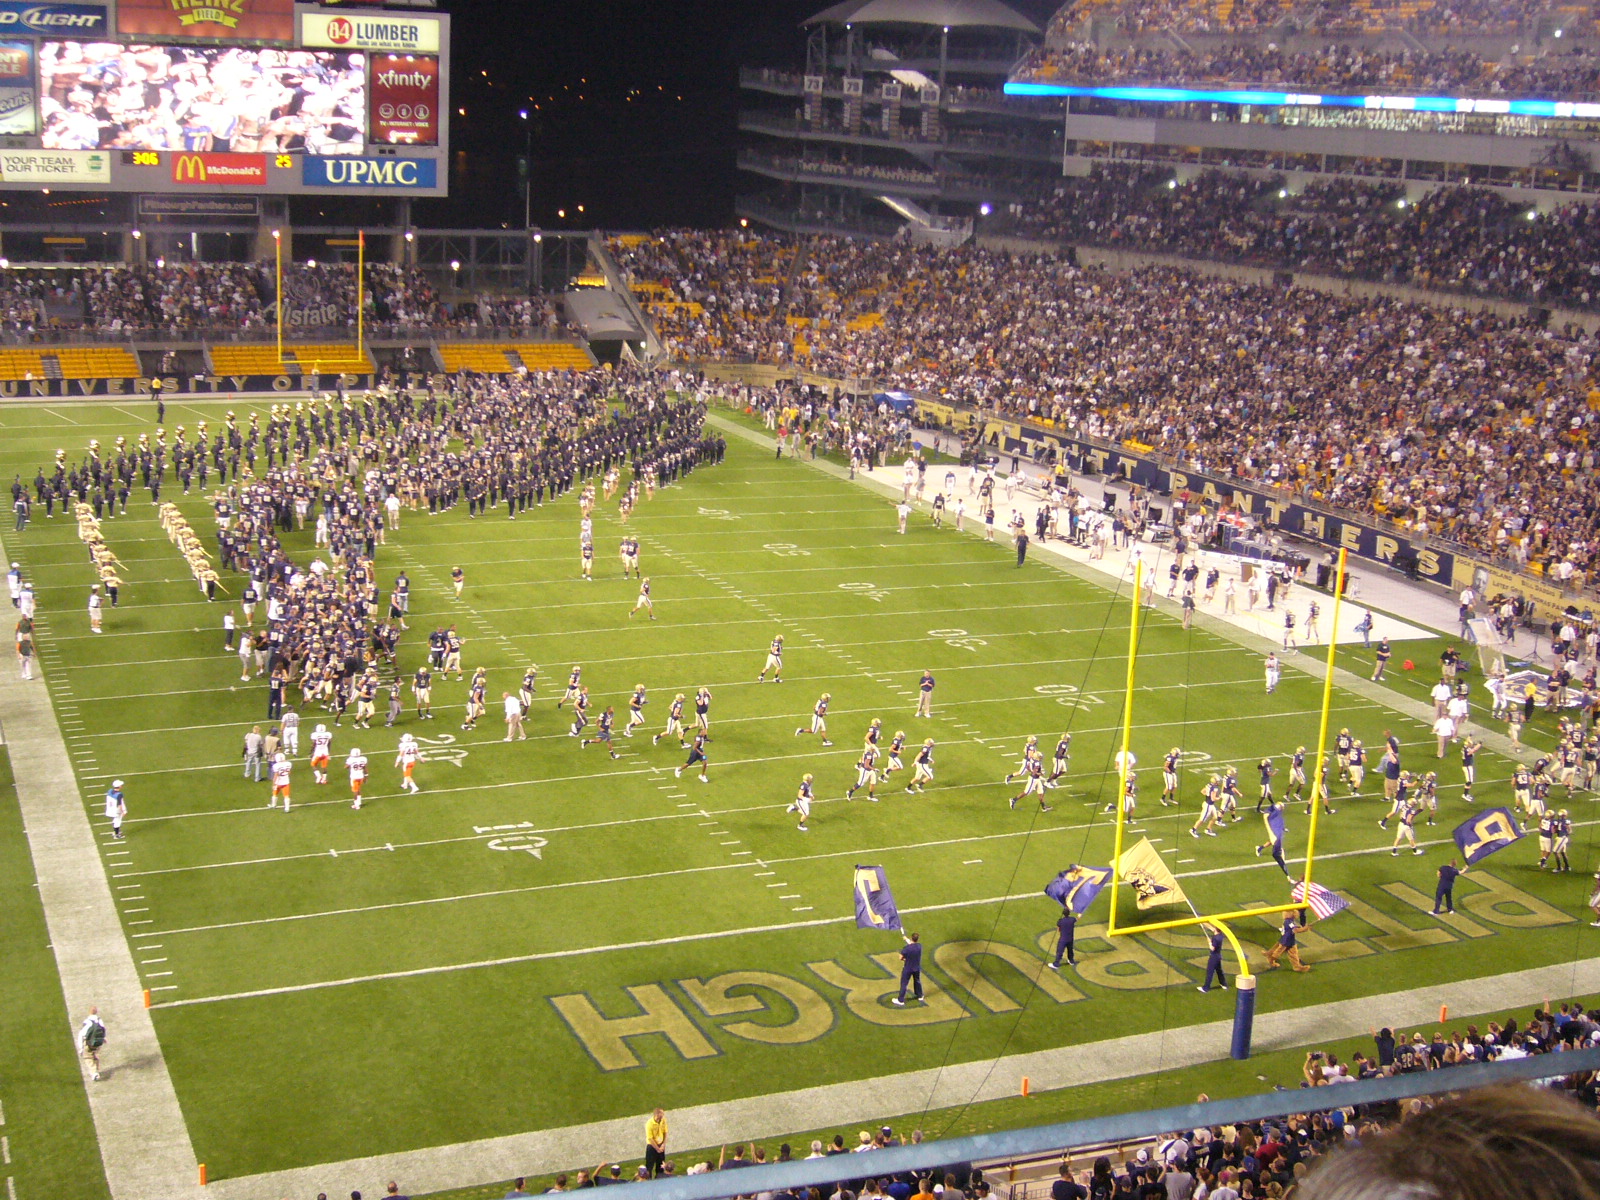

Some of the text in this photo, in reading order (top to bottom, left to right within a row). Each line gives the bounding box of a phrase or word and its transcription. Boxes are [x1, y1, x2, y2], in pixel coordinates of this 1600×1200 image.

[30, 12, 102, 27] LIGHT
[197, 10, 221, 20] FIELD
[356, 22, 419, 42] LUMBER
[377, 69, 432, 90] xfinity
[4, 156, 76, 165] YOUR TEAM.
[36, 165, 78, 173] TICKET.
[207, 165, 261, 175] McDonald's
[323, 159, 418, 185] UPMC
[0, 376, 249, 398] UNIVERSITY
[1169, 471, 1440, 576] PANTHERS
[927, 628, 988, 652] 30
[1034, 684, 1106, 712] 20
[318, 737, 329, 746] 57
[472, 820, 549, 854] 10
[546, 868, 1583, 1074] PITTSBURGH
